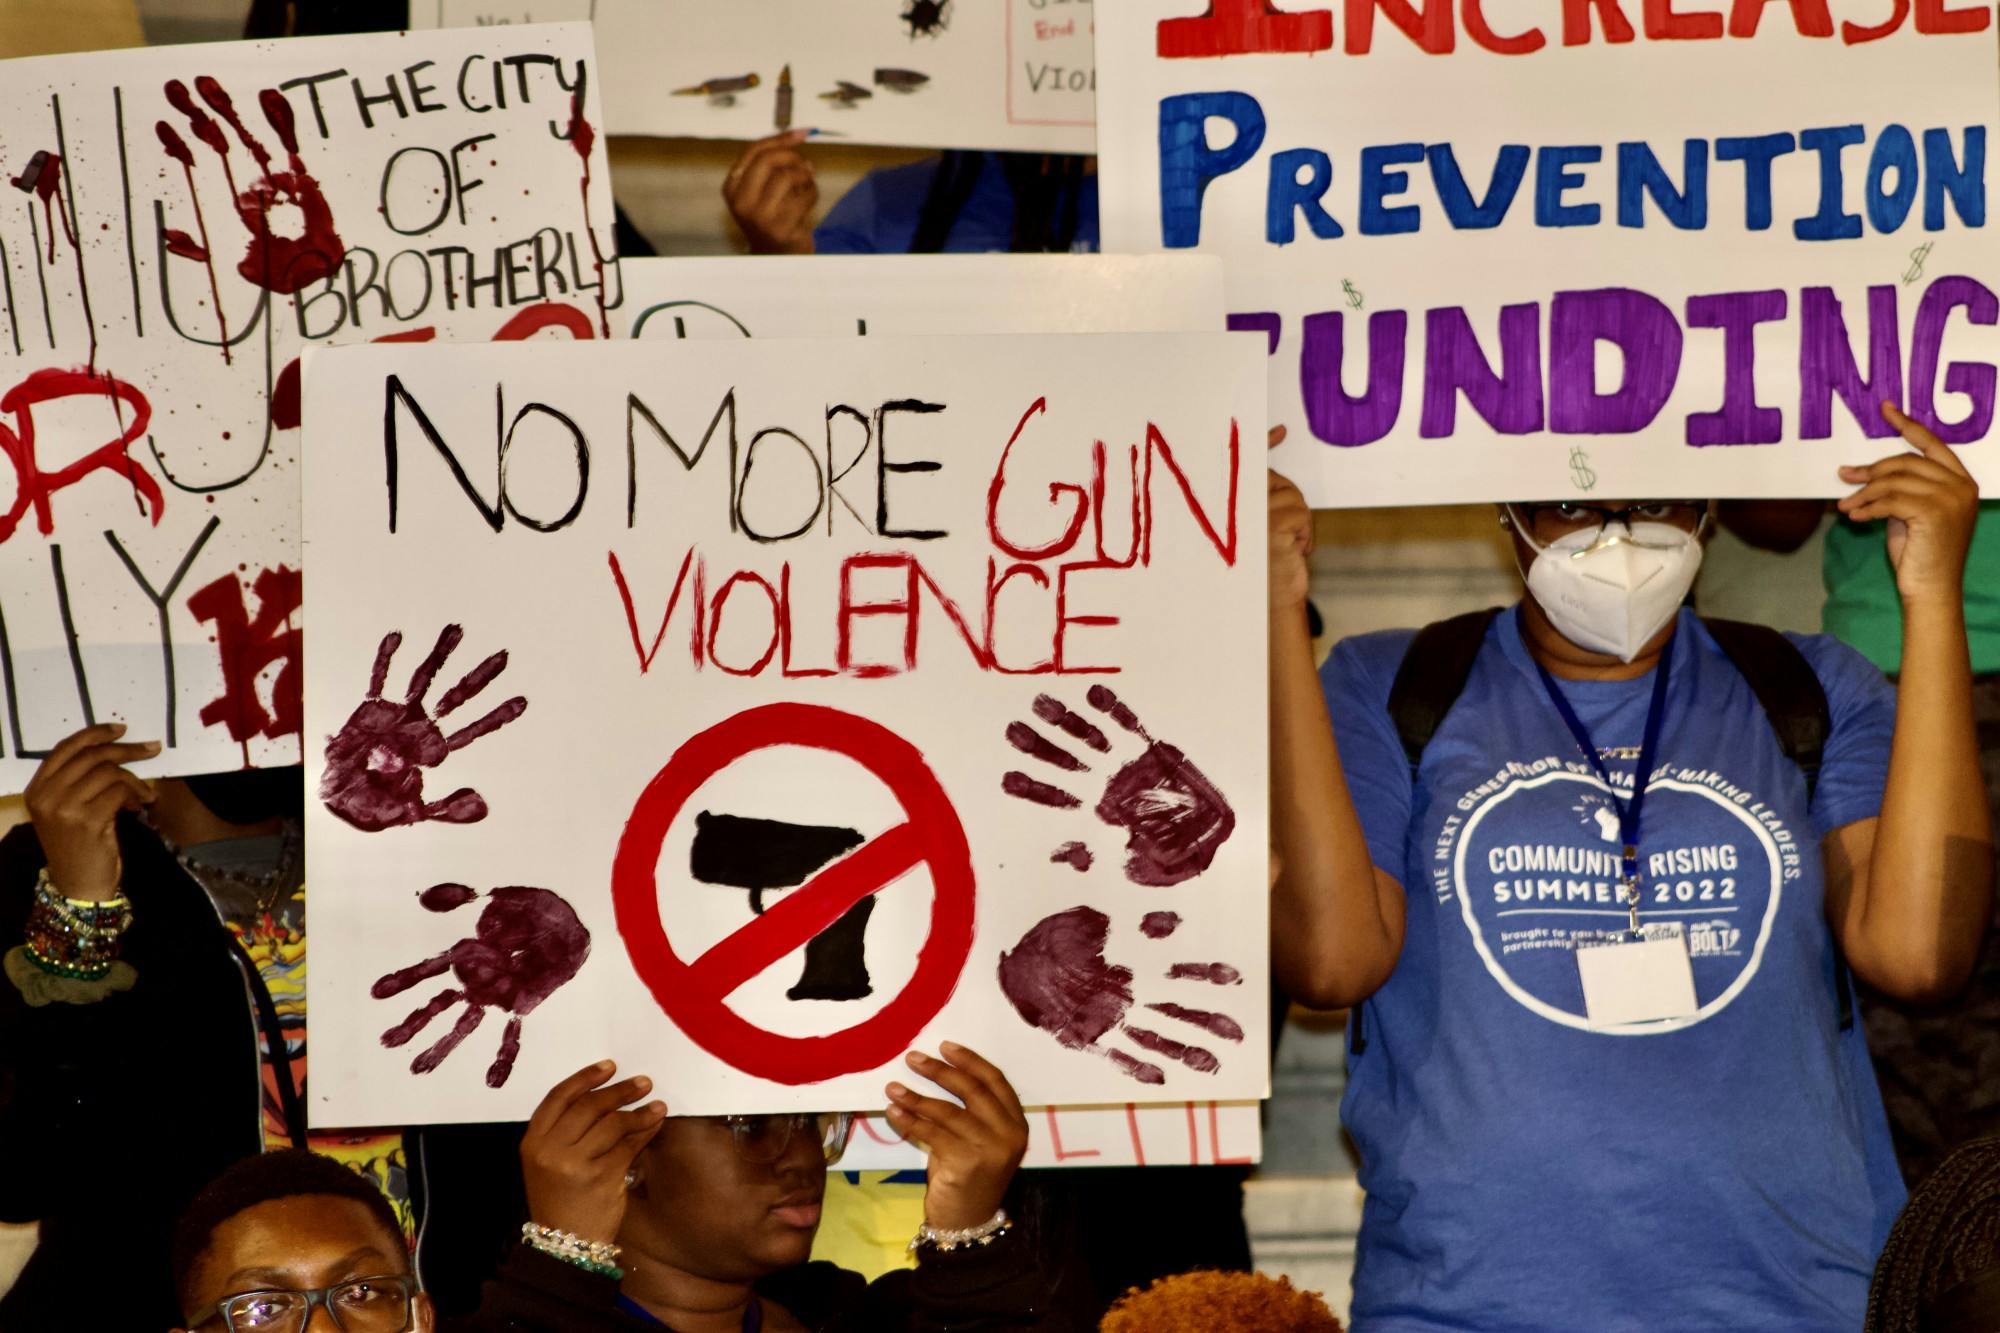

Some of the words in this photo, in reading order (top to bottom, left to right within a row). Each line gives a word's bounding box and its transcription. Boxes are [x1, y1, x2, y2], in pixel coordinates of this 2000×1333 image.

[279, 60, 447, 139] THE
[380, 132, 497, 236] OF
[1158, 90, 1987, 250] PREVENTION
[1227, 275, 1998, 447] UNDING
[386, 374, 591, 534] NO
[627, 385, 951, 543] MORE
[986, 395, 1240, 568] GUN
[608, 546, 1123, 680] VIOLENCE
[1456, 756, 1563, 812] GENERATION
[1434, 815, 1463, 861] NEXT
[1488, 844, 1623, 879] COMMUNIT
[1649, 844, 1739, 878] RISING
[1433, 867, 1453, 905] THE
[1493, 878, 1630, 904] SUMMER
[1654, 877, 1736, 903] 2022
